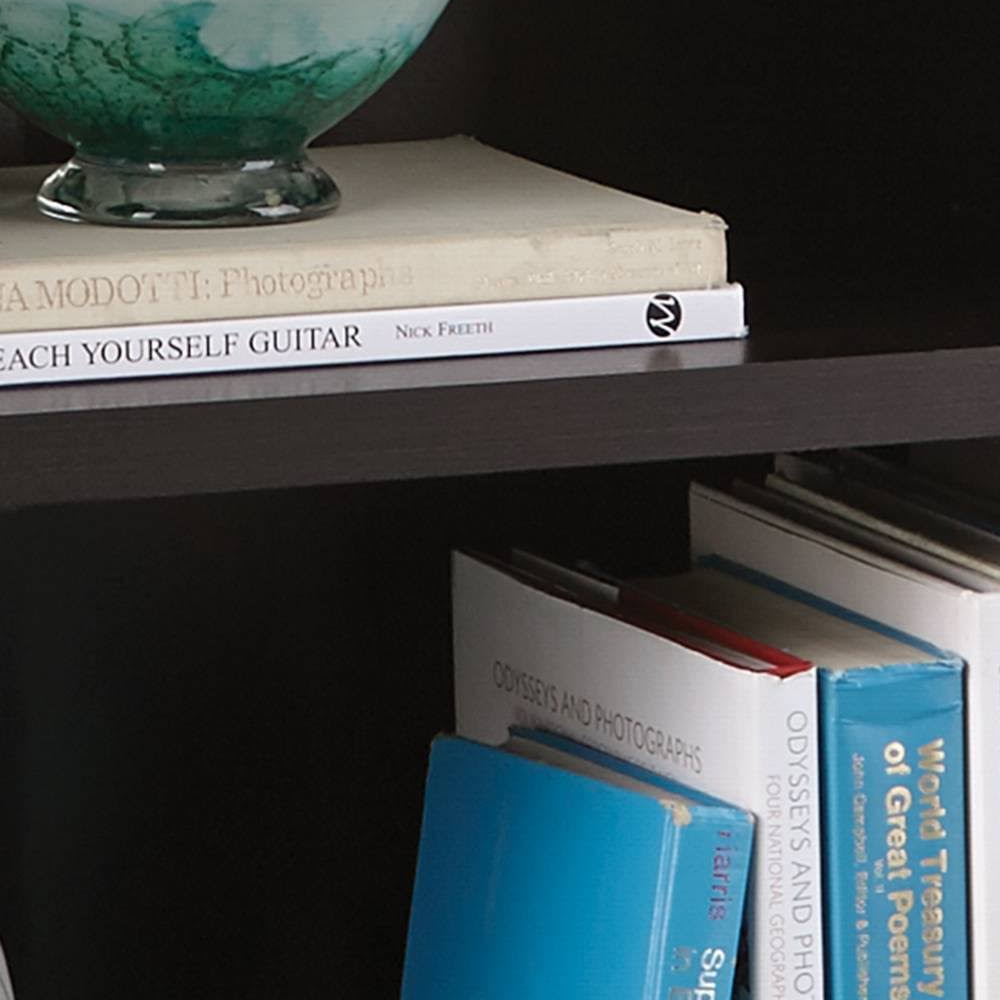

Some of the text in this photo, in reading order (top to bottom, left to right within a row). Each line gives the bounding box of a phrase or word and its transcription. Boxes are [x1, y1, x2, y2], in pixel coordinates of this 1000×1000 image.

[81, 332, 240, 366] YOURSELF
[249, 324, 363, 355] GUITAR
[492, 660, 559, 714] ODYSSEYS
[561, 690, 593, 727] AND
[594, 703, 704, 774] PHOTOGRAPHS
[766, 774, 782, 820] FOUR
[767, 824, 785, 910] NATIONAL
[787, 710, 815, 1000] ODYSSEYS AND PHO
[883, 740, 915, 1000] of Great Poems
[916, 738, 948, 998] World Treasury
